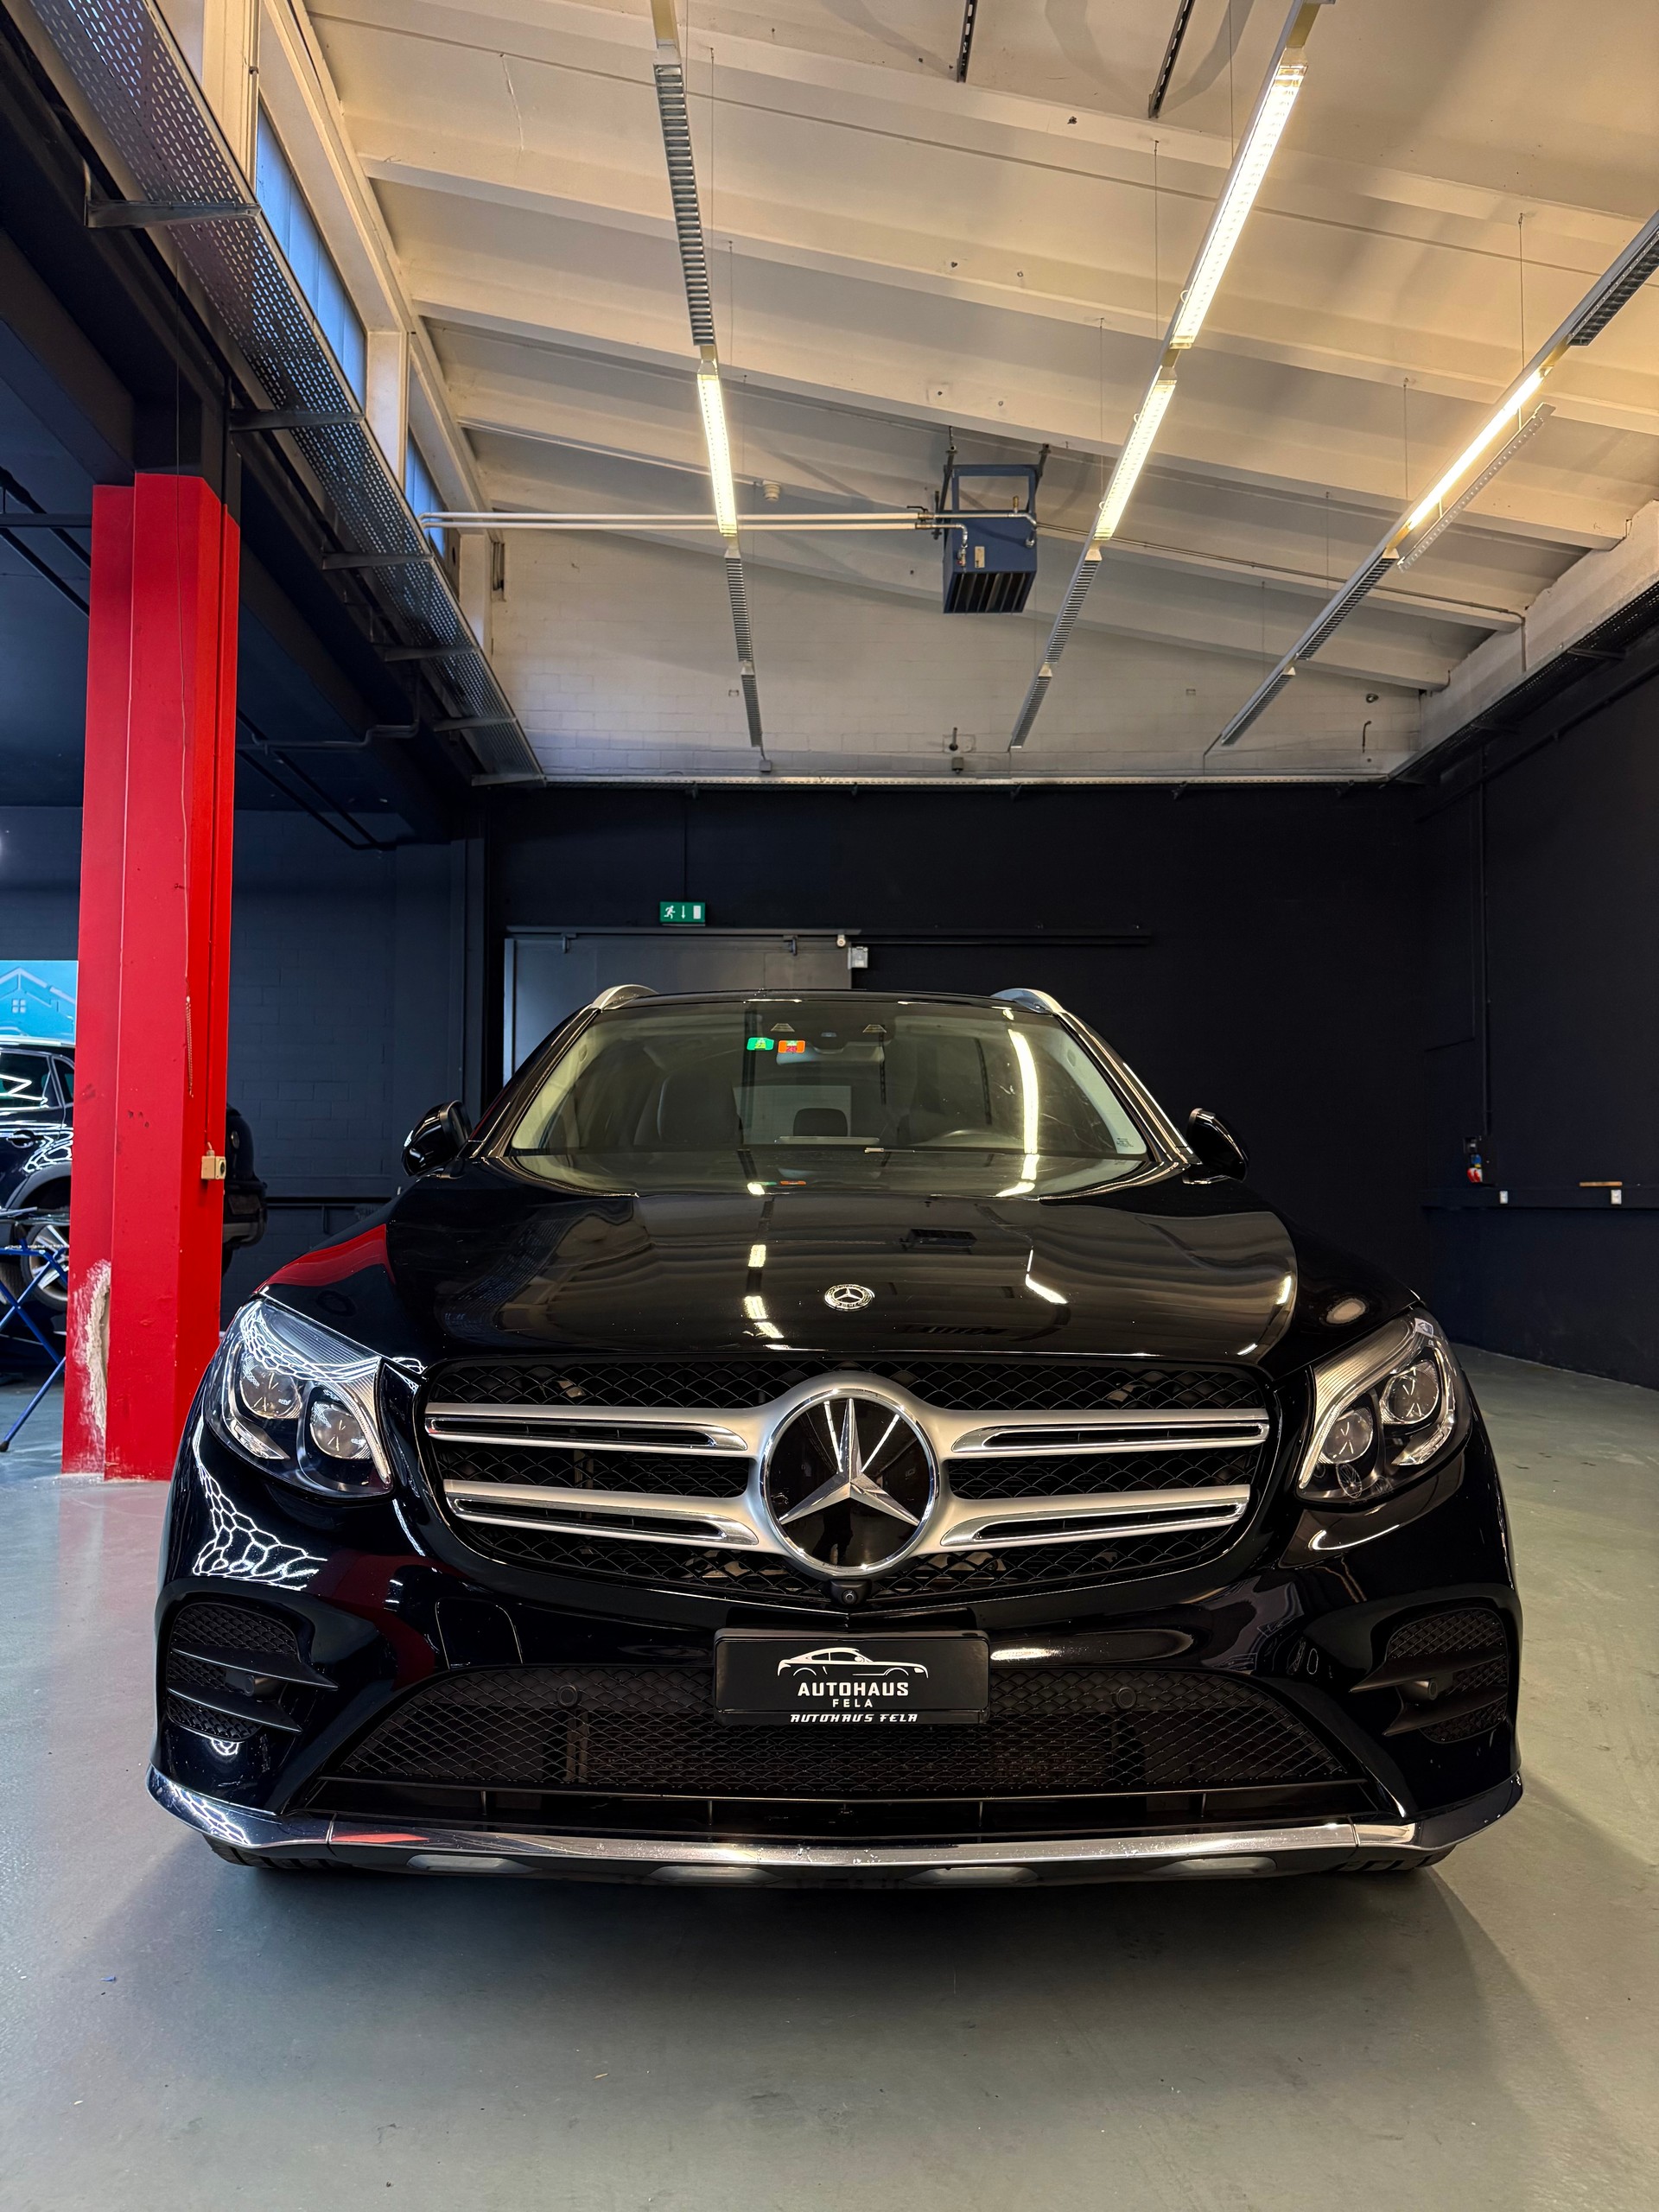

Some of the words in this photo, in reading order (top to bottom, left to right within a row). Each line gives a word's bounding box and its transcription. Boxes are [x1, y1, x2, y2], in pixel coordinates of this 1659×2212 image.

[798, 1681, 909, 1697] AUTOHAUS
[832, 1698, 873, 1708] FELA
[790, 1713, 874, 1723] AUTOHAUS
[880, 1713, 918, 1723] FELA
